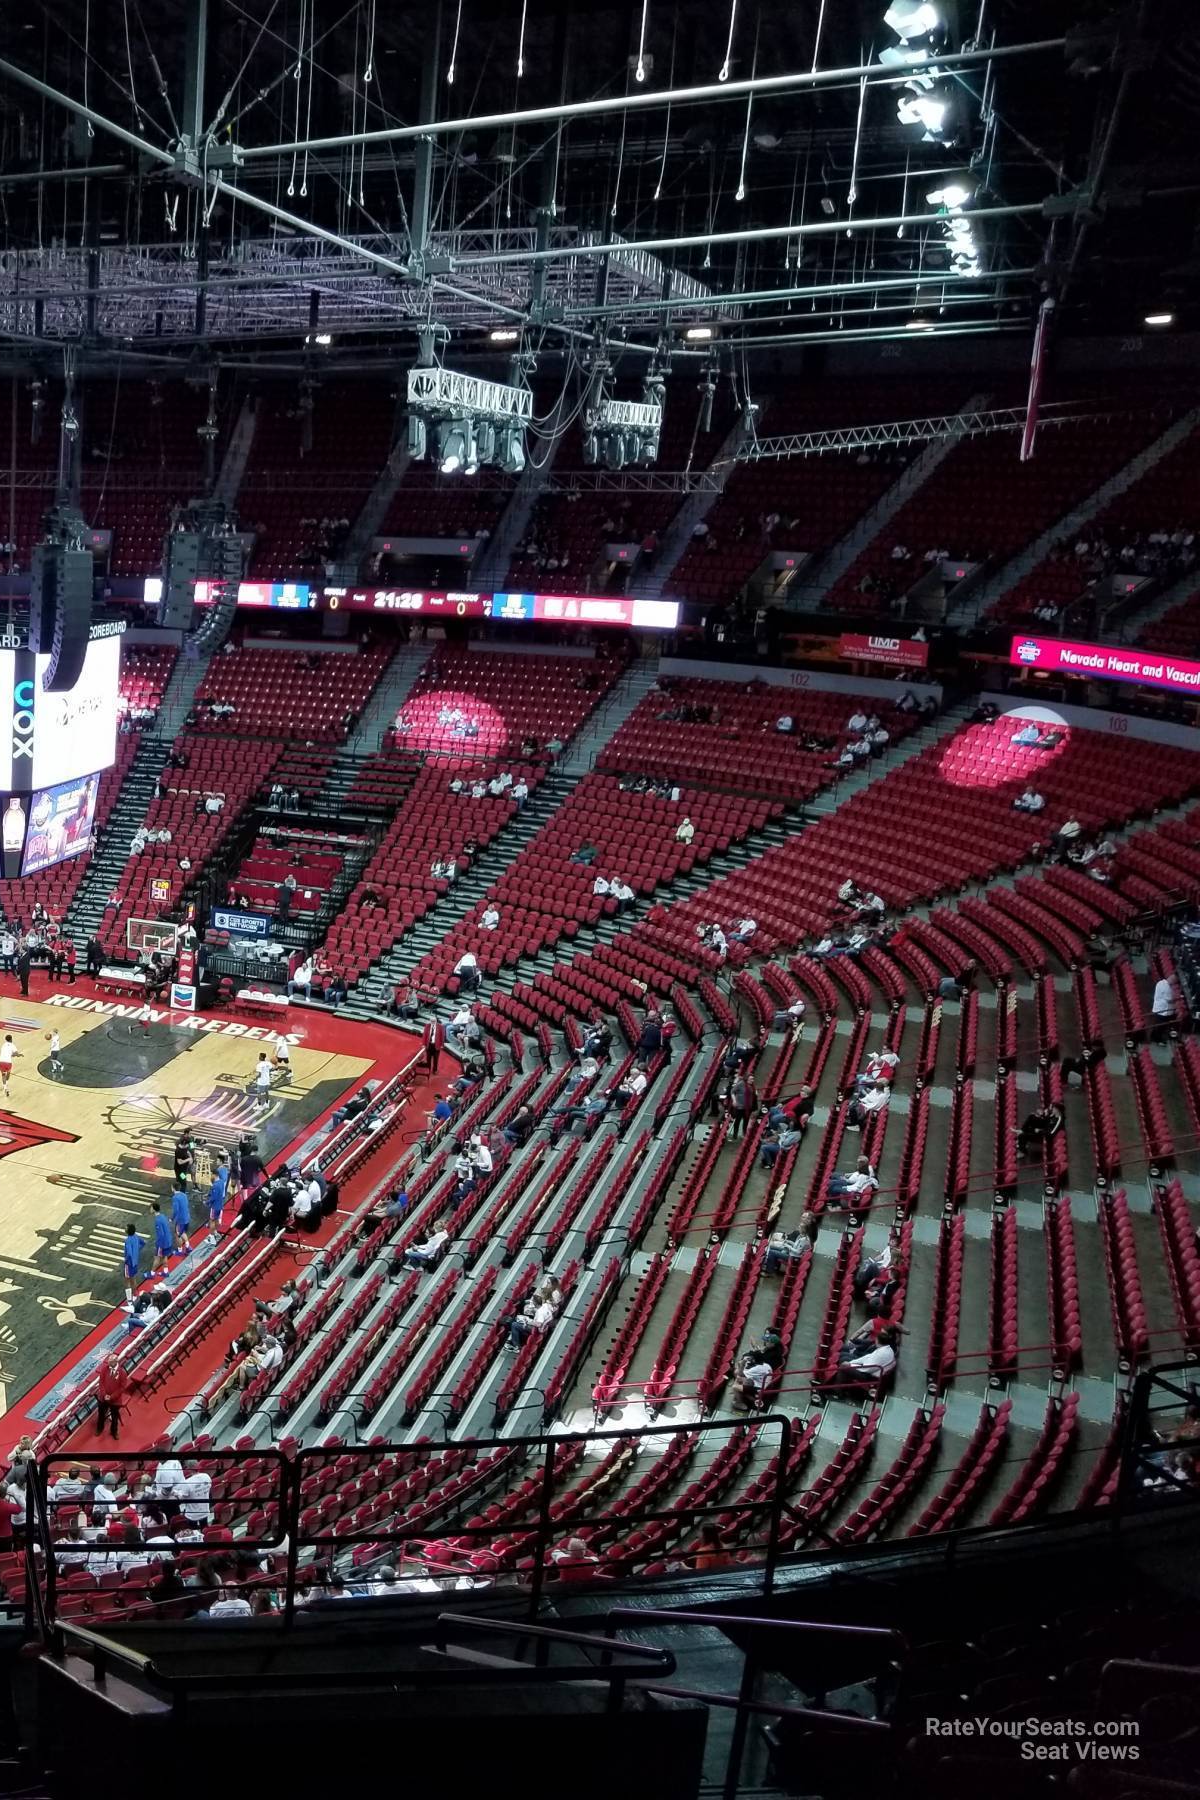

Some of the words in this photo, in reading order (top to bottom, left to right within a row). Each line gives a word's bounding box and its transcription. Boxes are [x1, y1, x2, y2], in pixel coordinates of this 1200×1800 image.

[330, 597, 338, 608] 0
[457, 602, 466, 615] 0
[868, 636, 900, 650] UMC
[1060, 649, 1104, 667] Nevada
[1108, 657, 1140, 674] Heart
[1143, 665, 1163, 677] and
[790, 673, 810, 687] 102
[13, 680, 35, 759] COX
[1109, 716, 1128, 733] 103
[229, 922, 258, 931] NETWORK
[178, 1015, 305, 1046] REBELS
